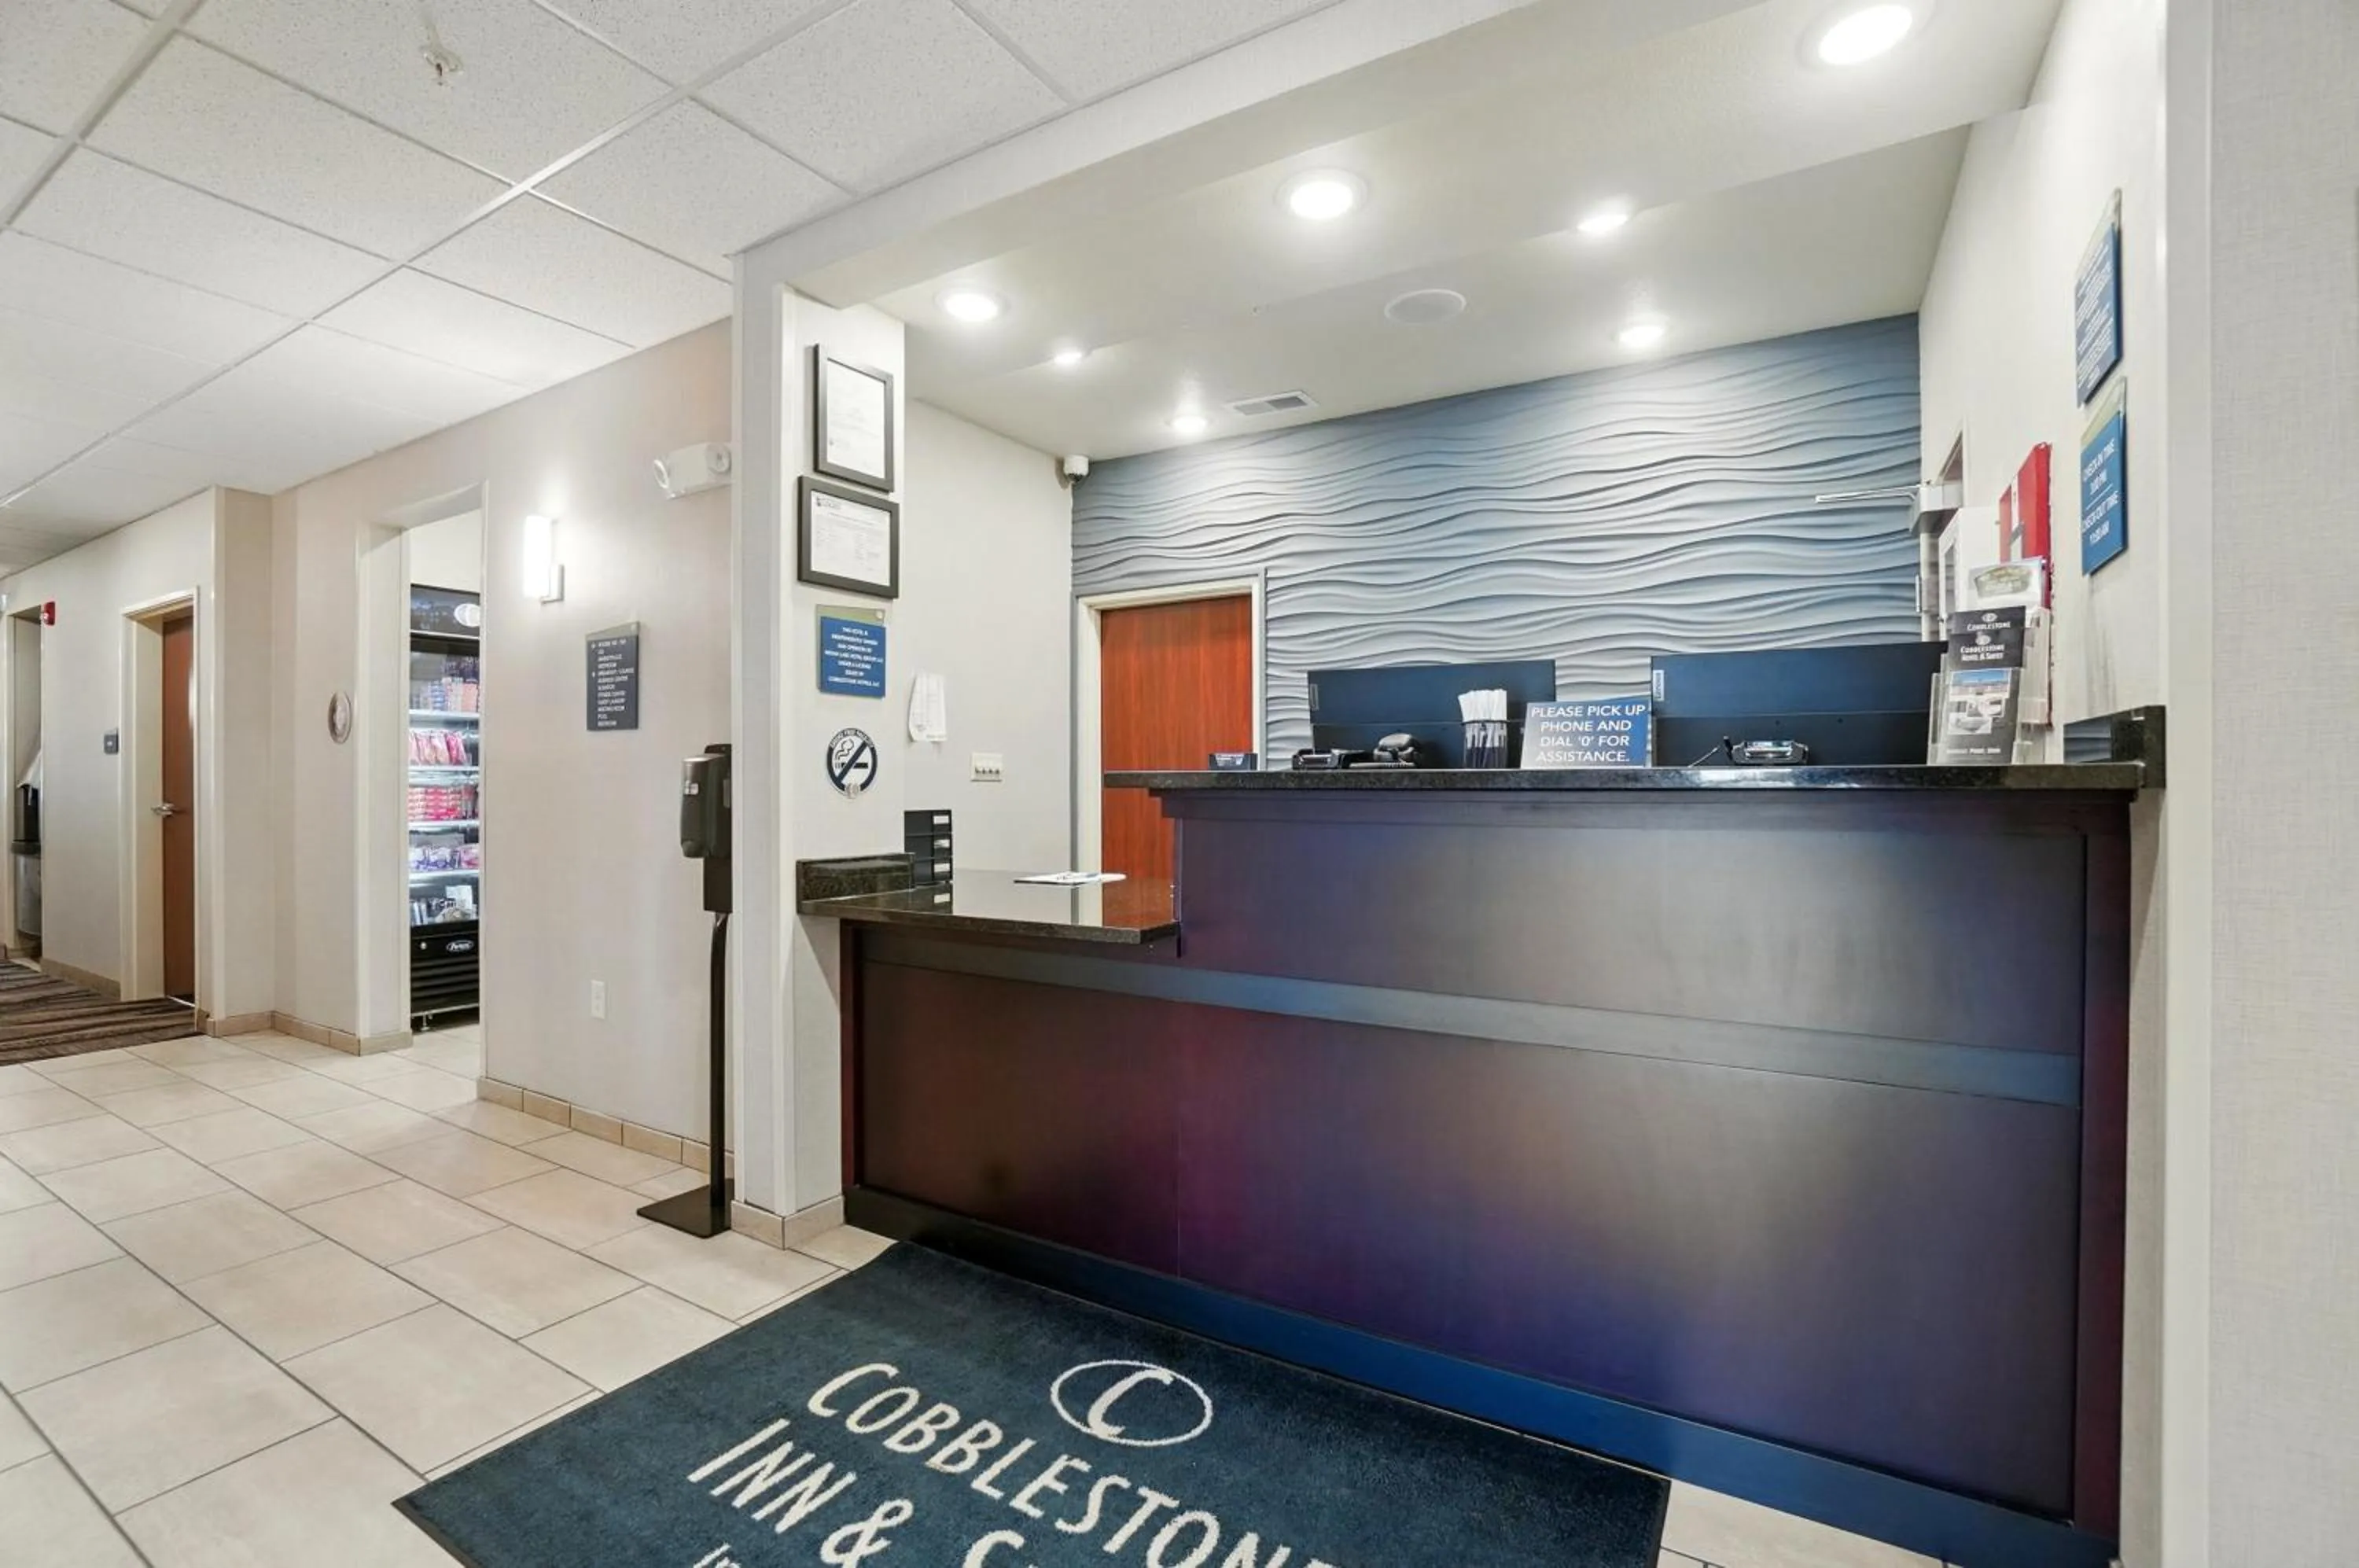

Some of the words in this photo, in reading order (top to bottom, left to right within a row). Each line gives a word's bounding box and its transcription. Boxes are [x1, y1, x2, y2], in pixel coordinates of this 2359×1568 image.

[1531, 705, 1584, 718] PLEASE
[1587, 705, 1621, 716] PICK
[1625, 704, 1647, 716] UP
[1540, 720, 1594, 732] PHONE
[1597, 720, 1632, 731] AND
[1539, 736, 1573, 747] DIAL
[1598, 735, 1630, 746] FOR
[1535, 750, 1630, 763] ASSISTANCE.
[808, 1363, 1338, 1568] COBBLESTON
[686, 1418, 858, 1534] INN
[819, 1498, 915, 1568] &
